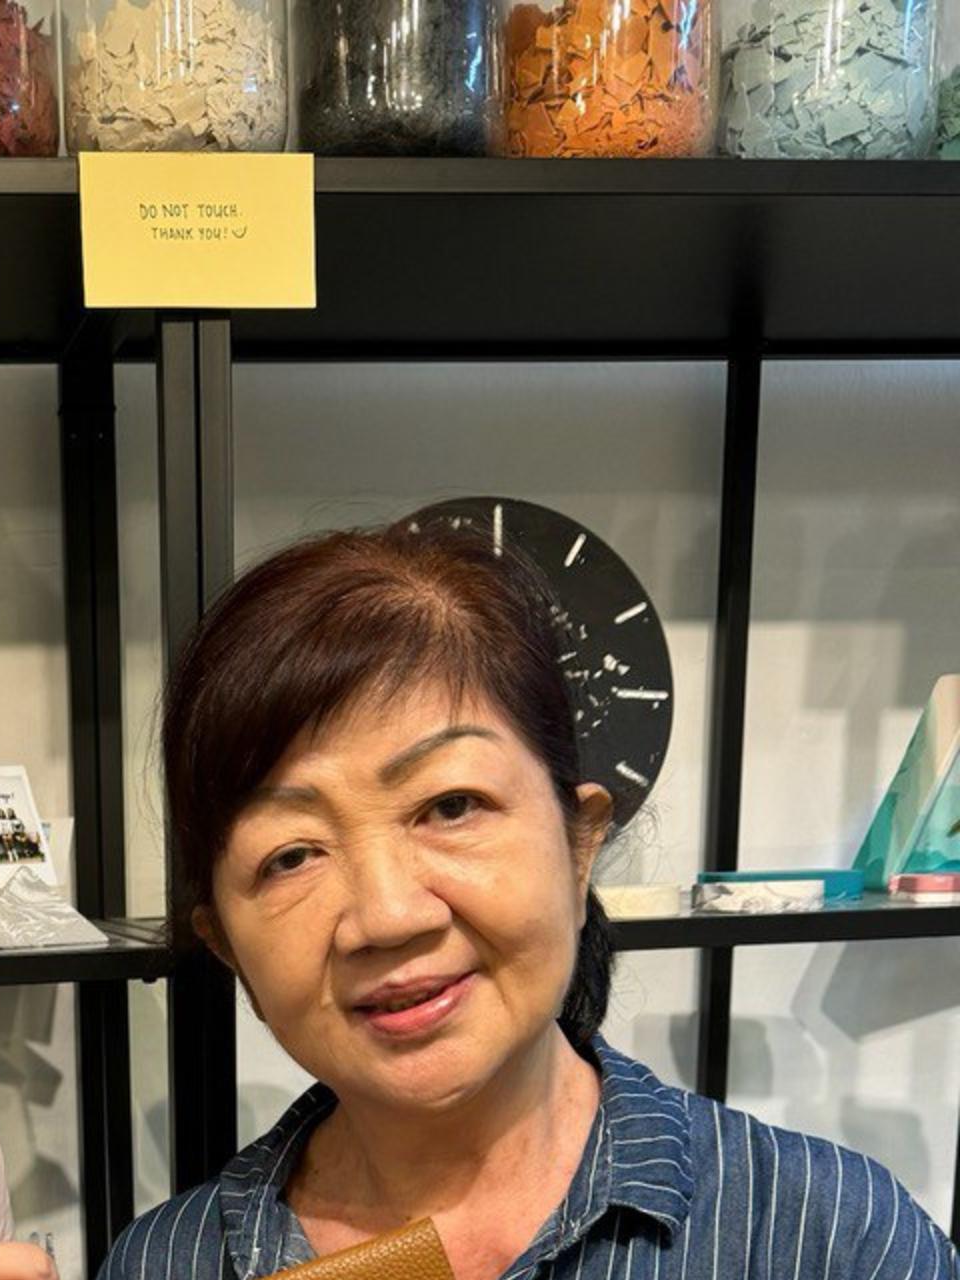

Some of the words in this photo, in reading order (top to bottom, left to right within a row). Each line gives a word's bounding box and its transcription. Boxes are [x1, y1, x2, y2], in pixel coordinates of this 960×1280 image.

[139, 203, 158, 220] DO
[161, 203, 189, 219] NOT
[151, 226, 193, 240] THANK
[198, 226, 228, 240] YOU!
